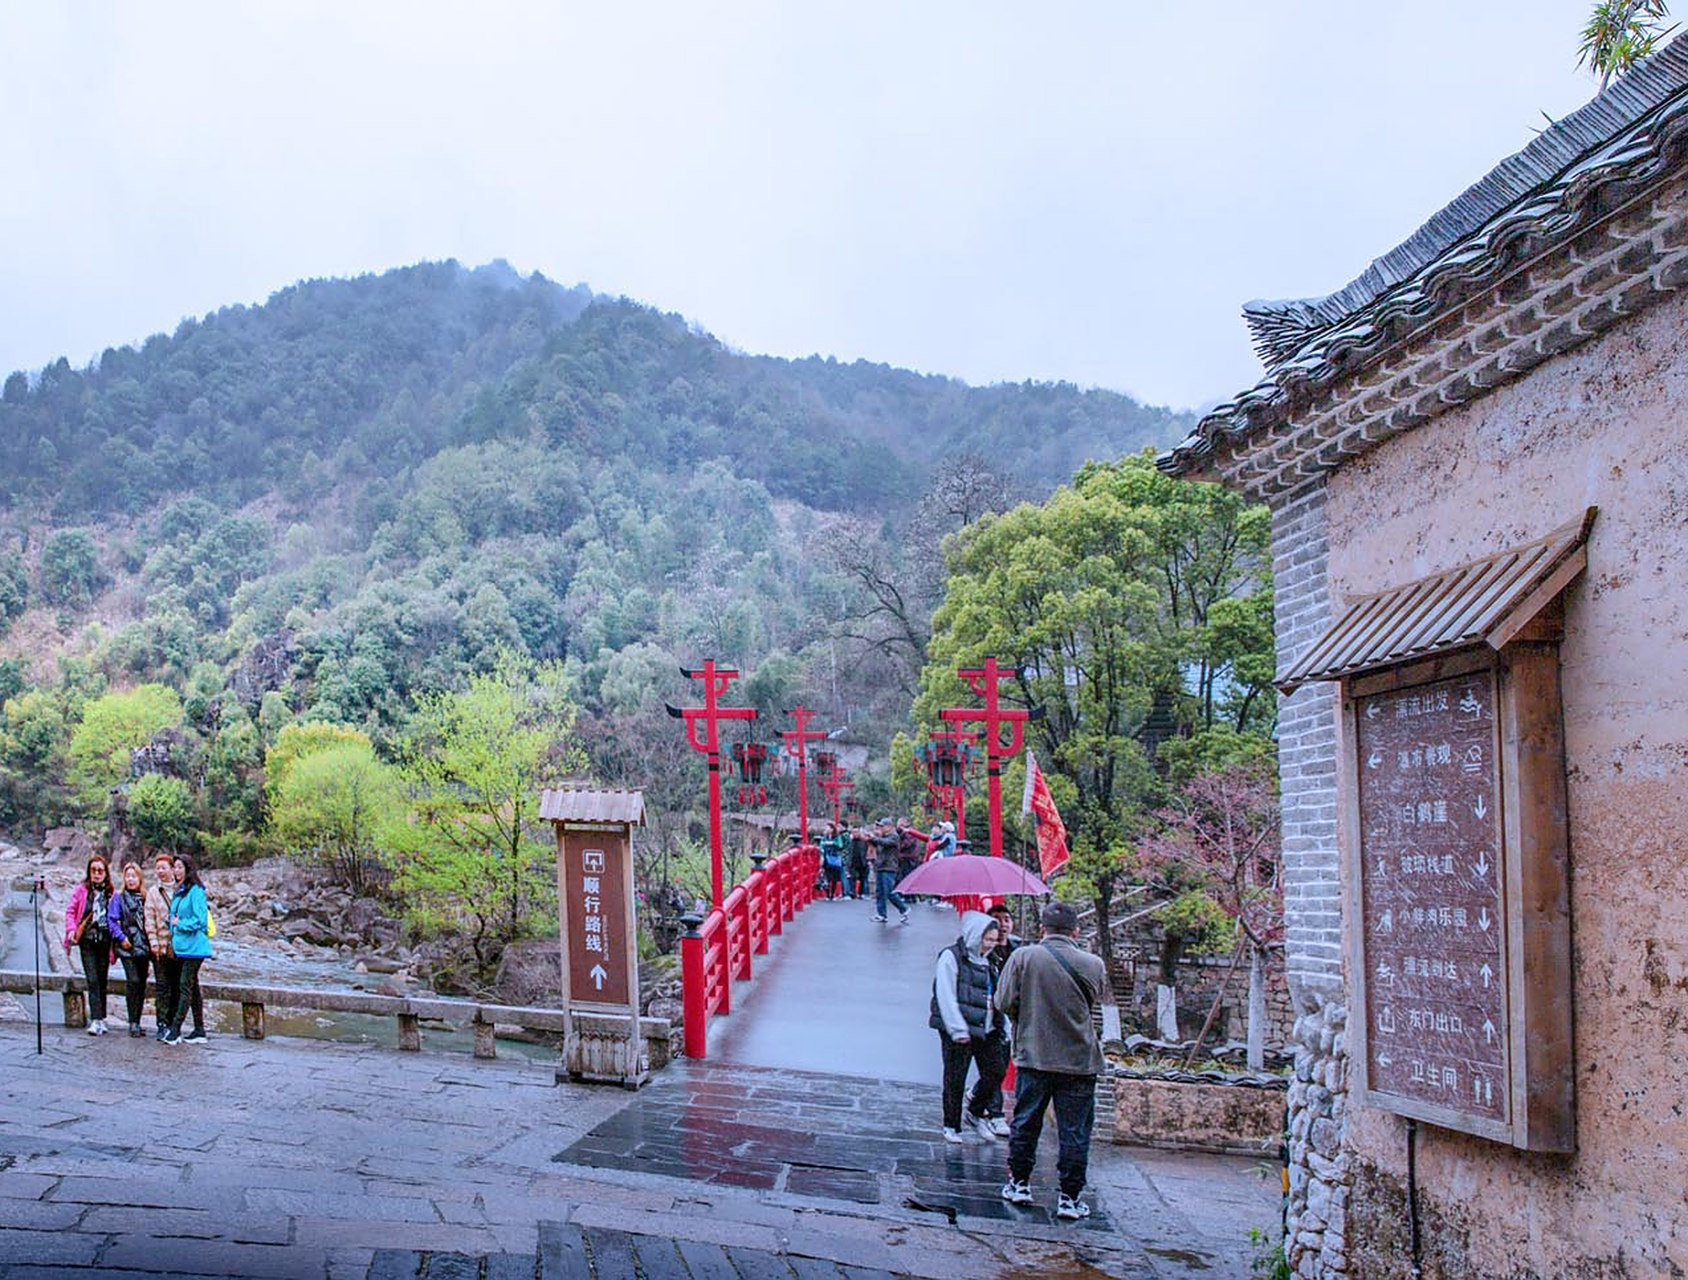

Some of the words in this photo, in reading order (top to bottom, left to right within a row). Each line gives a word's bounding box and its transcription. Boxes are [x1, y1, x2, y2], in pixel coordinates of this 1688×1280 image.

[583, 877, 602, 952] 顺行路线
[1409, 1008, 1463, 1033] 东门出口
[1411, 1060, 1457, 1091] 卫生间
